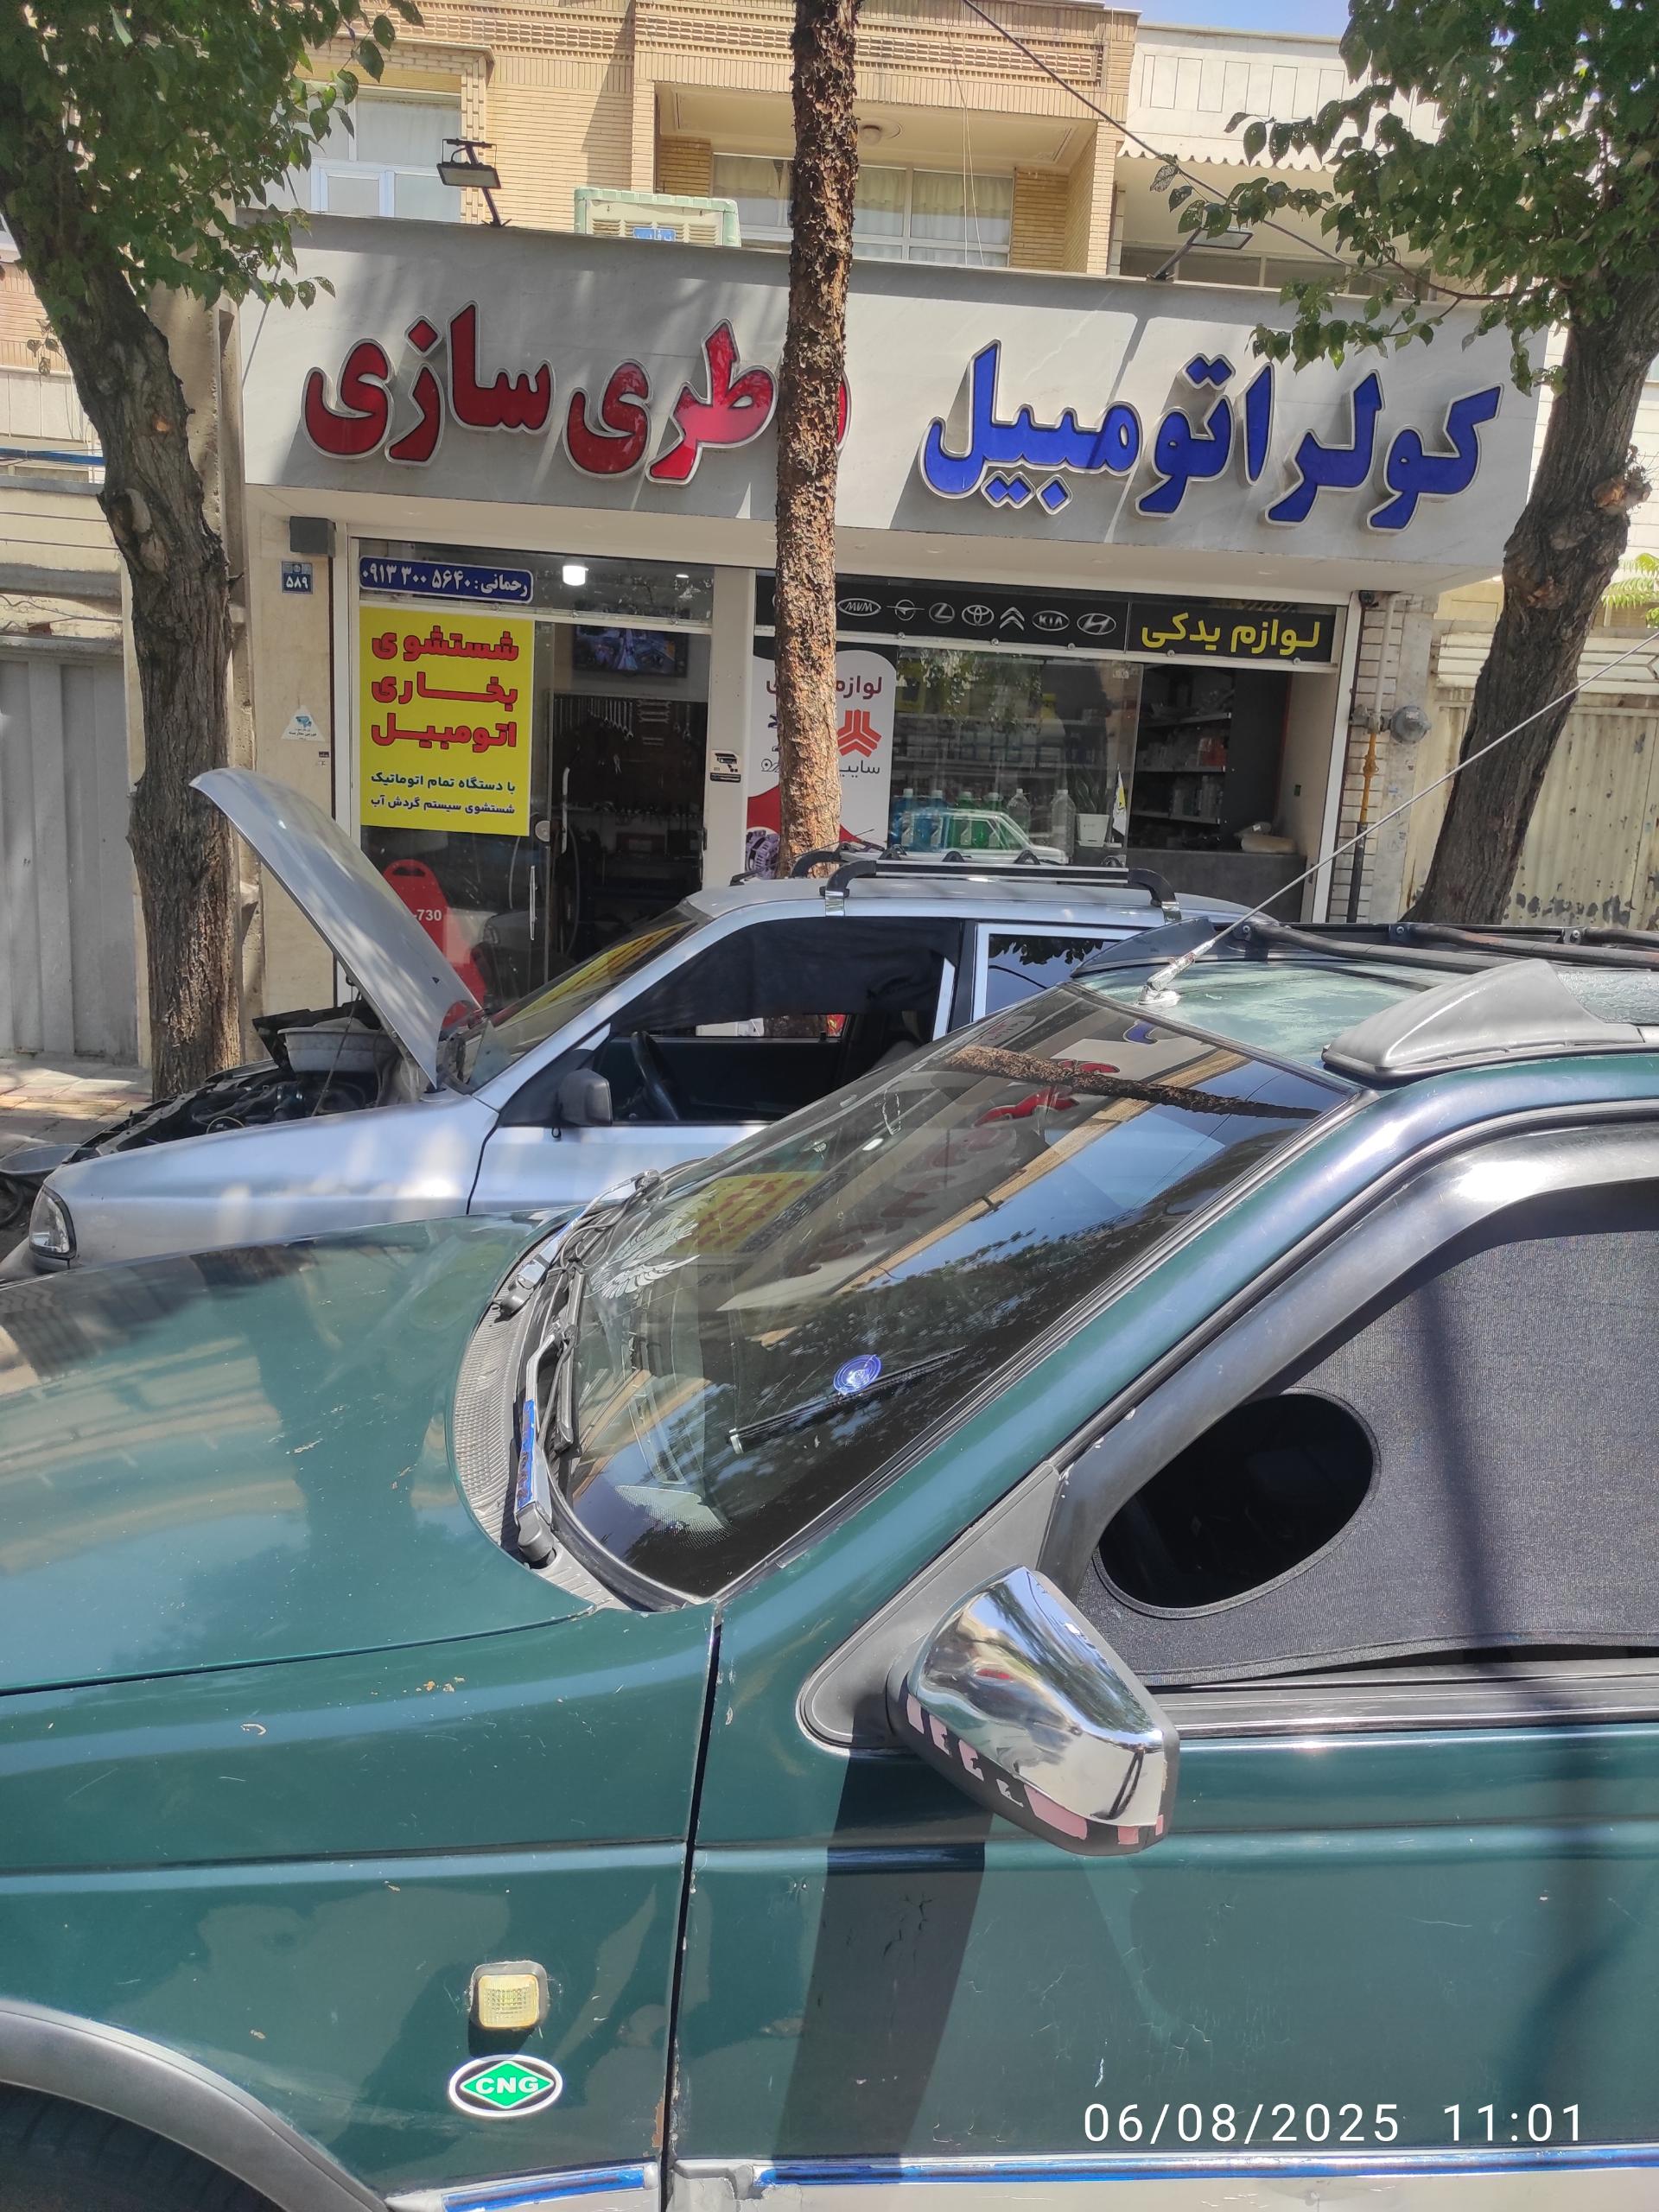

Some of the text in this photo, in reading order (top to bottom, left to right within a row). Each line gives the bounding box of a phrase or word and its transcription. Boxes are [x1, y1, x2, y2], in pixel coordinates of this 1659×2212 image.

[302, 299, 555, 467] سازی
[920, 338, 1274, 517] اتومبیل
[1266, 367, 1504, 533] کولر
[286, 575, 308, 589] ۵۸۹
[1039, 614, 1063, 627] KIA
[1141, 612, 1321, 657] لوازم یدکی
[371, 712, 518, 753] اتومبیل
[371, 772, 516, 795] با دستگاه تمام اتوماتیک
[371, 794, 516, 815] شستشوی سیستم گردش آب
[475, 2076, 539, 2094] CNG
